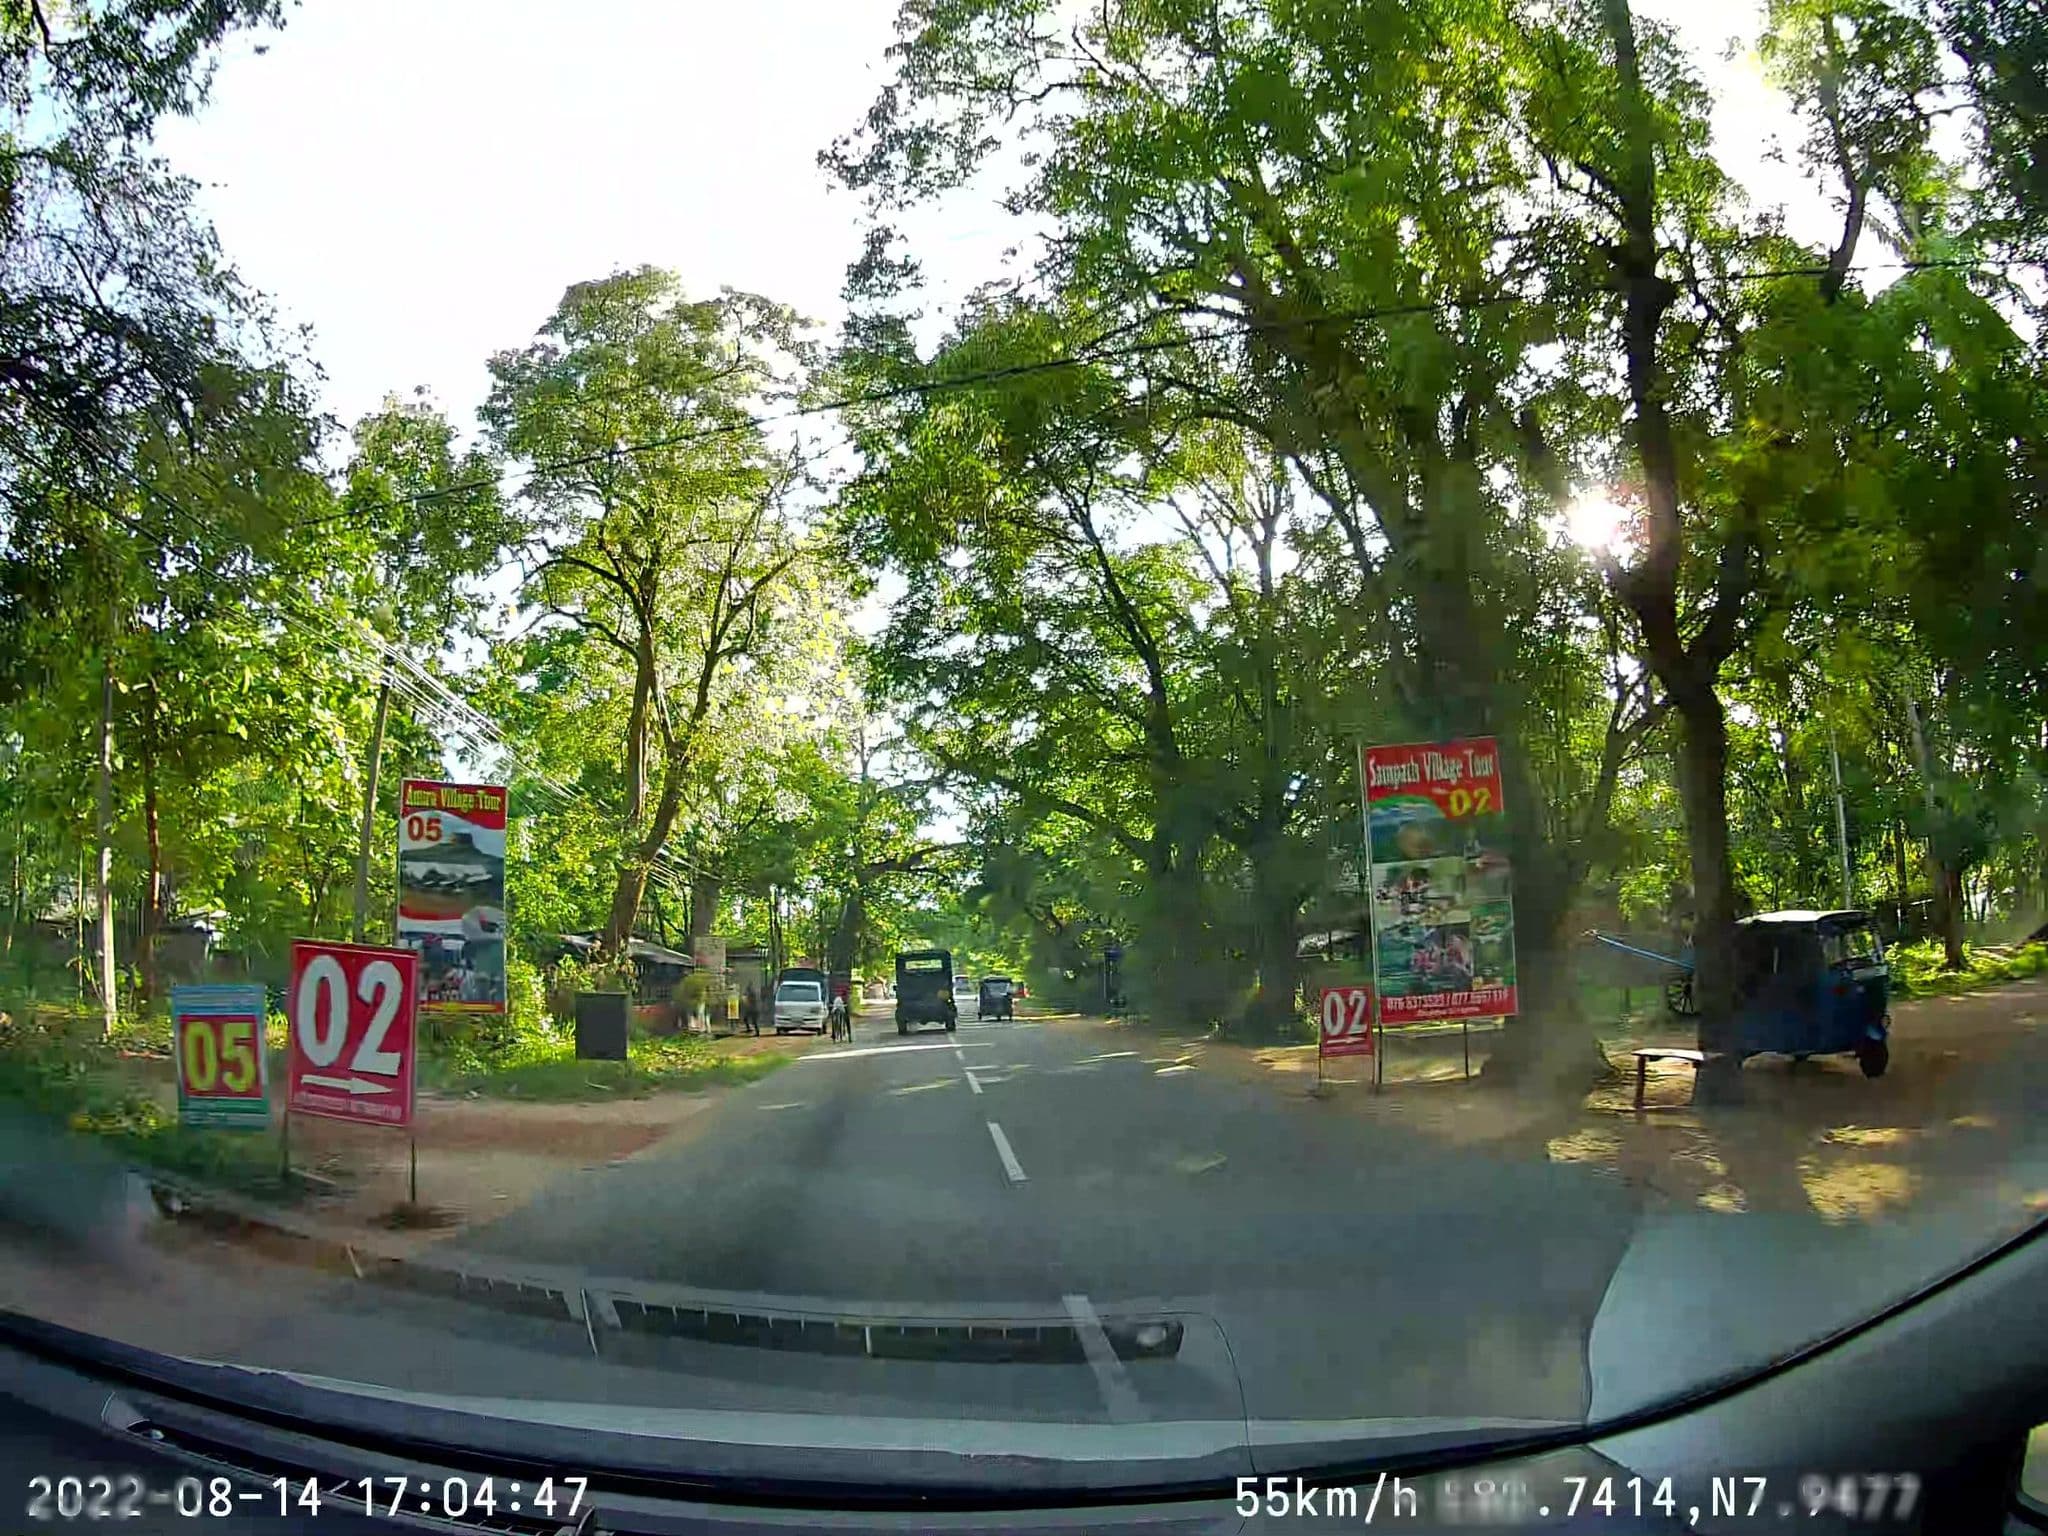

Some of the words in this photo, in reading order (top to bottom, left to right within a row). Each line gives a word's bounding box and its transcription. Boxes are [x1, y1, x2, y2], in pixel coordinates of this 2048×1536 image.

[1423, 751, 1463, 785] Village
[1463, 748, 1494, 778] Tour
[441, 787, 475, 812] Village
[476, 790, 501, 811] Tour
[1449, 788, 1491, 816] 02
[408, 816, 442, 842] 05
[297, 955, 403, 1076] 02
[1323, 989, 1368, 1036] 02
[184, 1021, 257, 1094] 05
